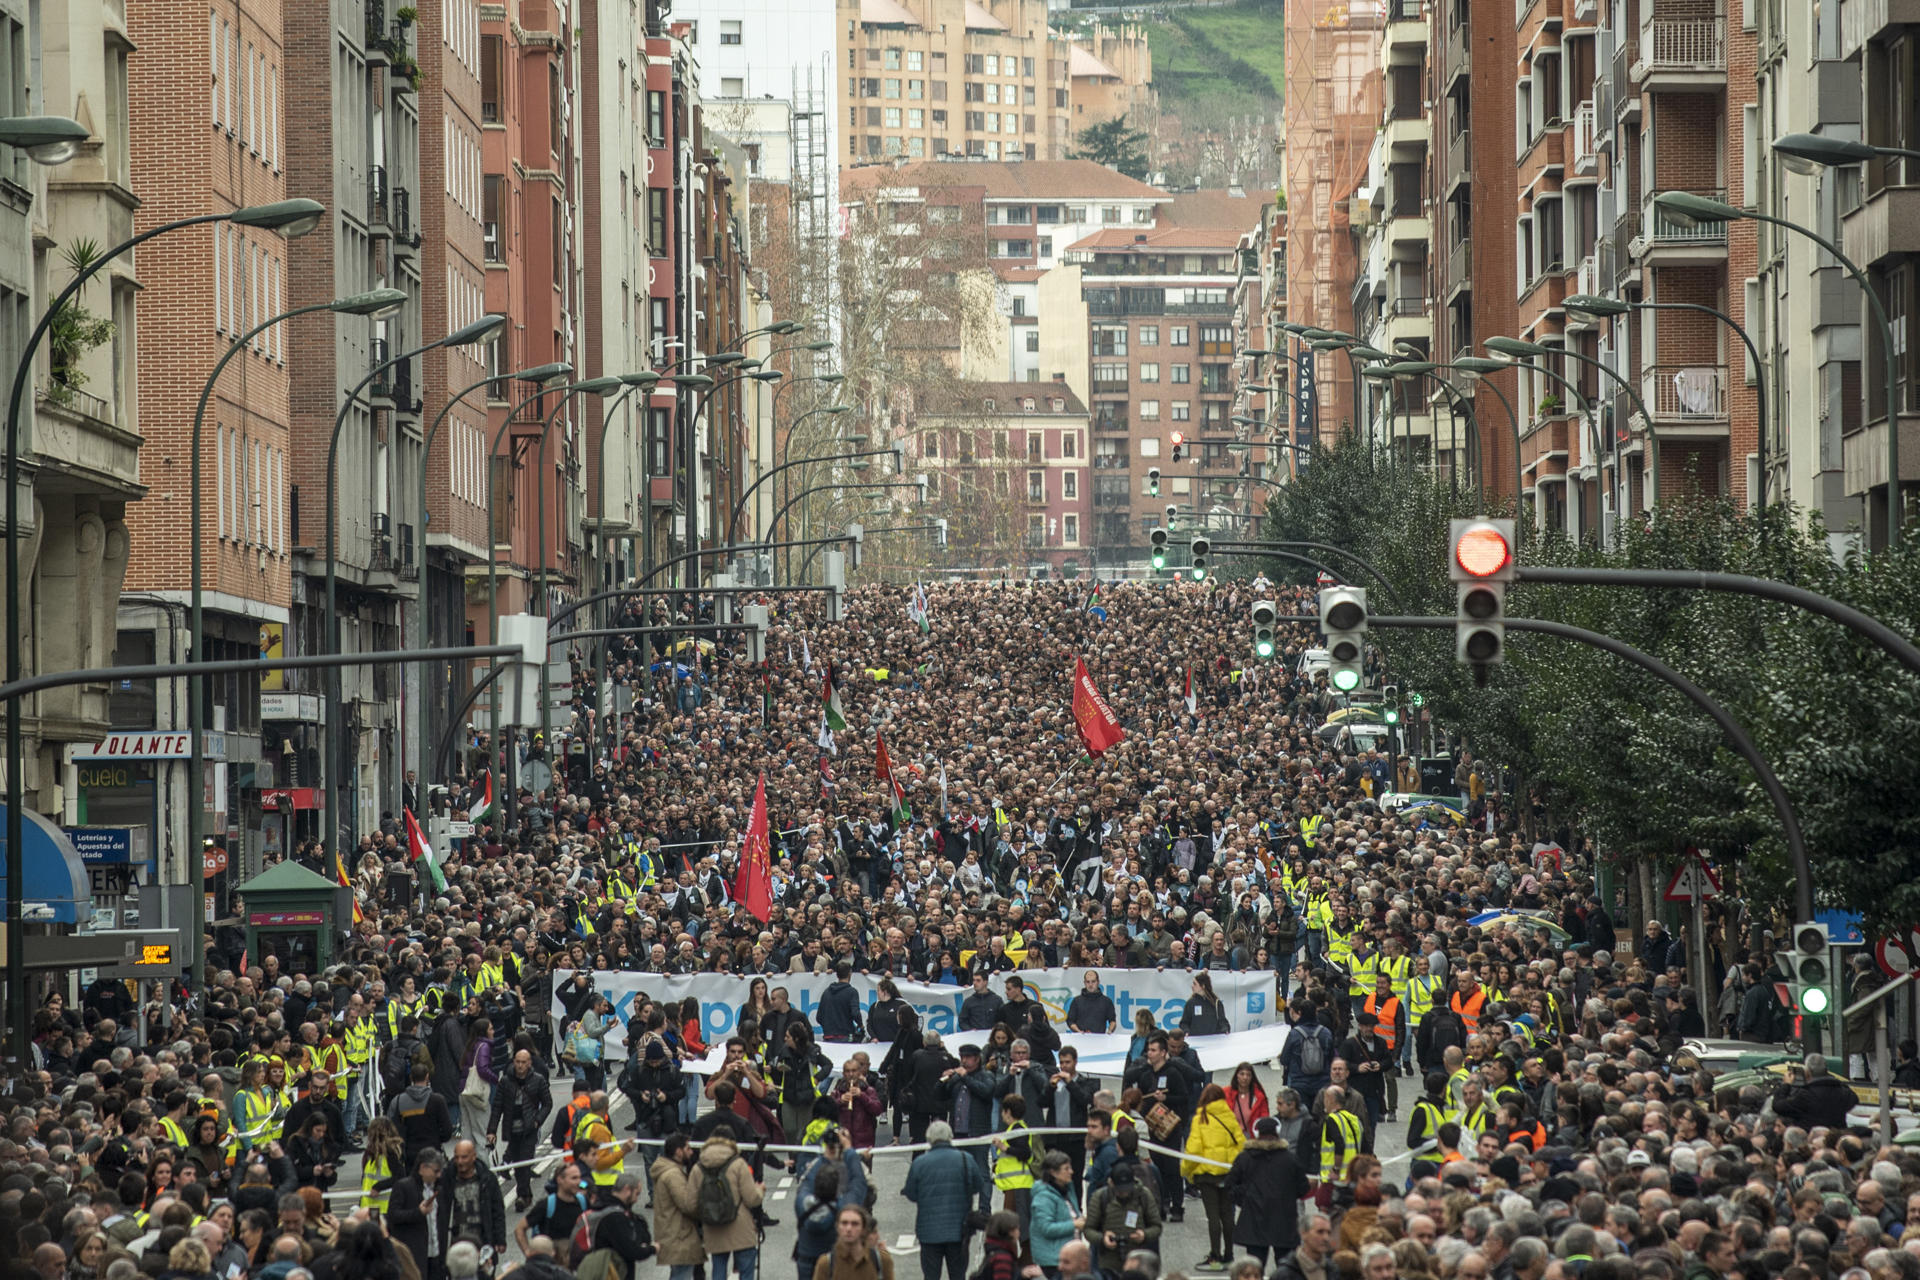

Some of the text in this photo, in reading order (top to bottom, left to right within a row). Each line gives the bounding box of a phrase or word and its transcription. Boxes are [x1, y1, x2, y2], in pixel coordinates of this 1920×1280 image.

[93, 735, 187, 755] VOLANTE
[78, 765, 127, 787] cuela
[77, 833, 114, 843] Loterías y
[77, 843, 111, 851] Apuestas
